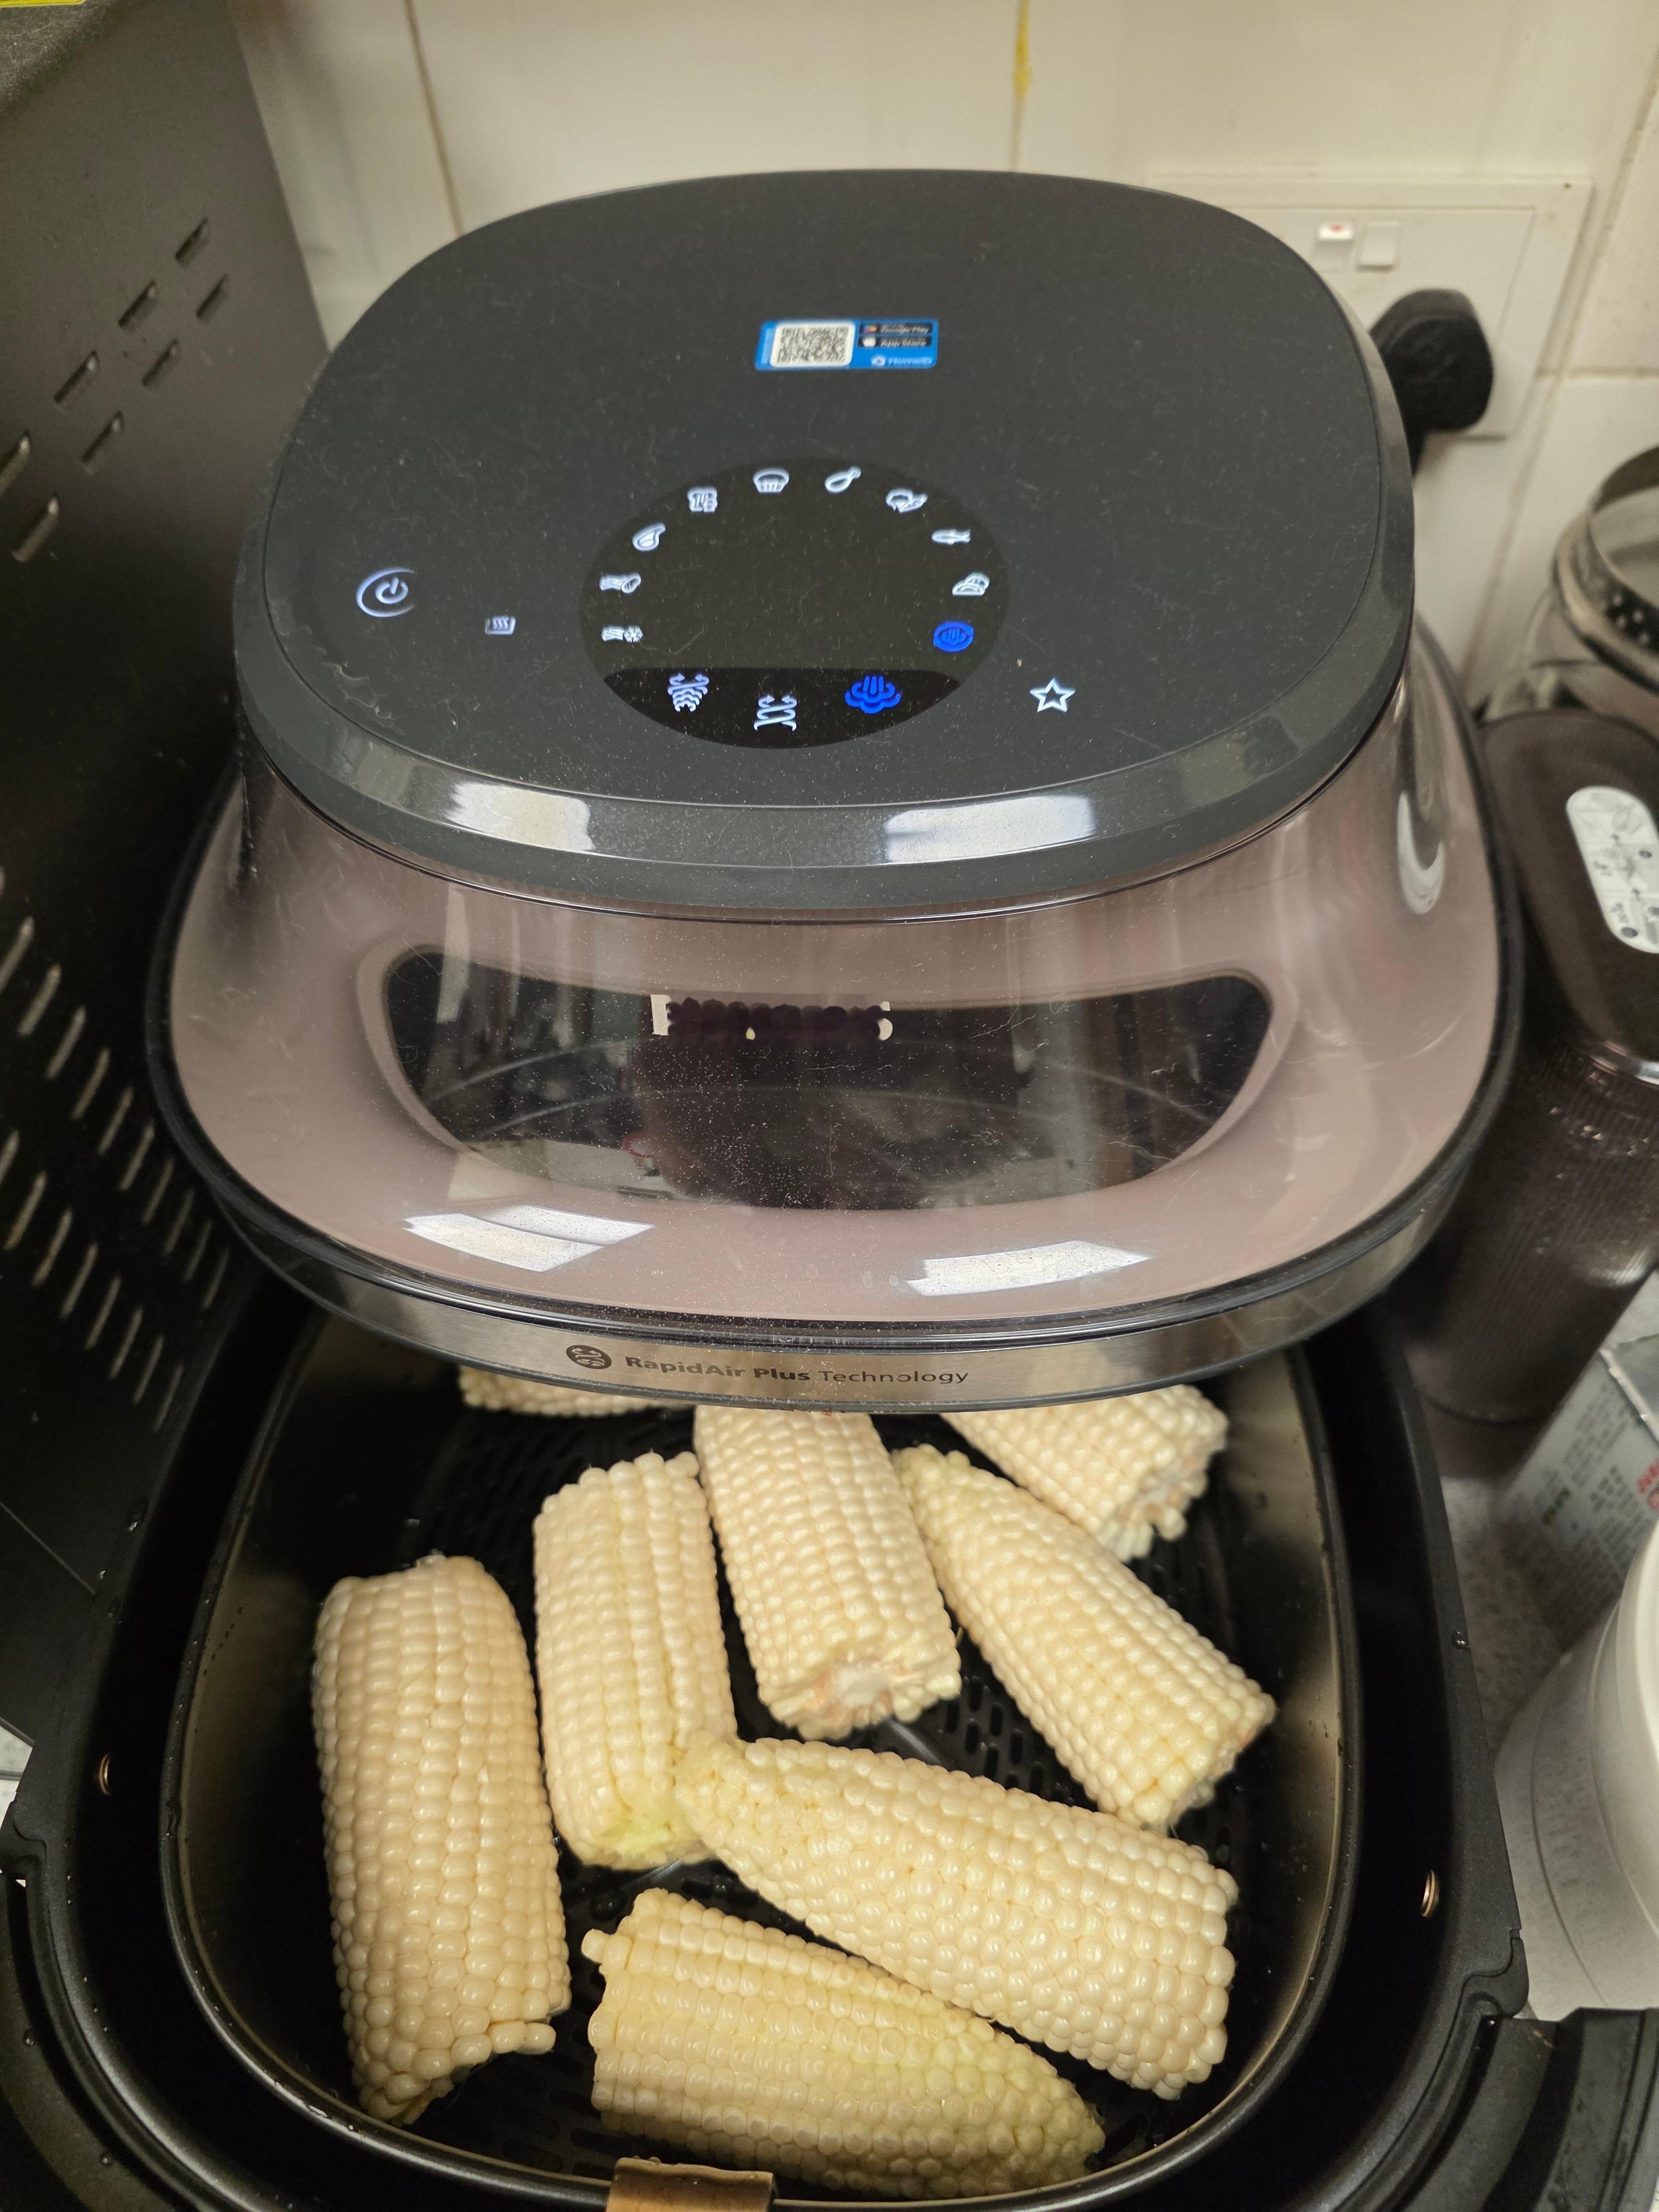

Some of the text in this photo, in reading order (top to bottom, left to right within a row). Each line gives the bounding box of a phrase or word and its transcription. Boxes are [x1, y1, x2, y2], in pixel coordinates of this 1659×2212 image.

[625, 1356, 969, 1384] RapidAir Plus Technology
